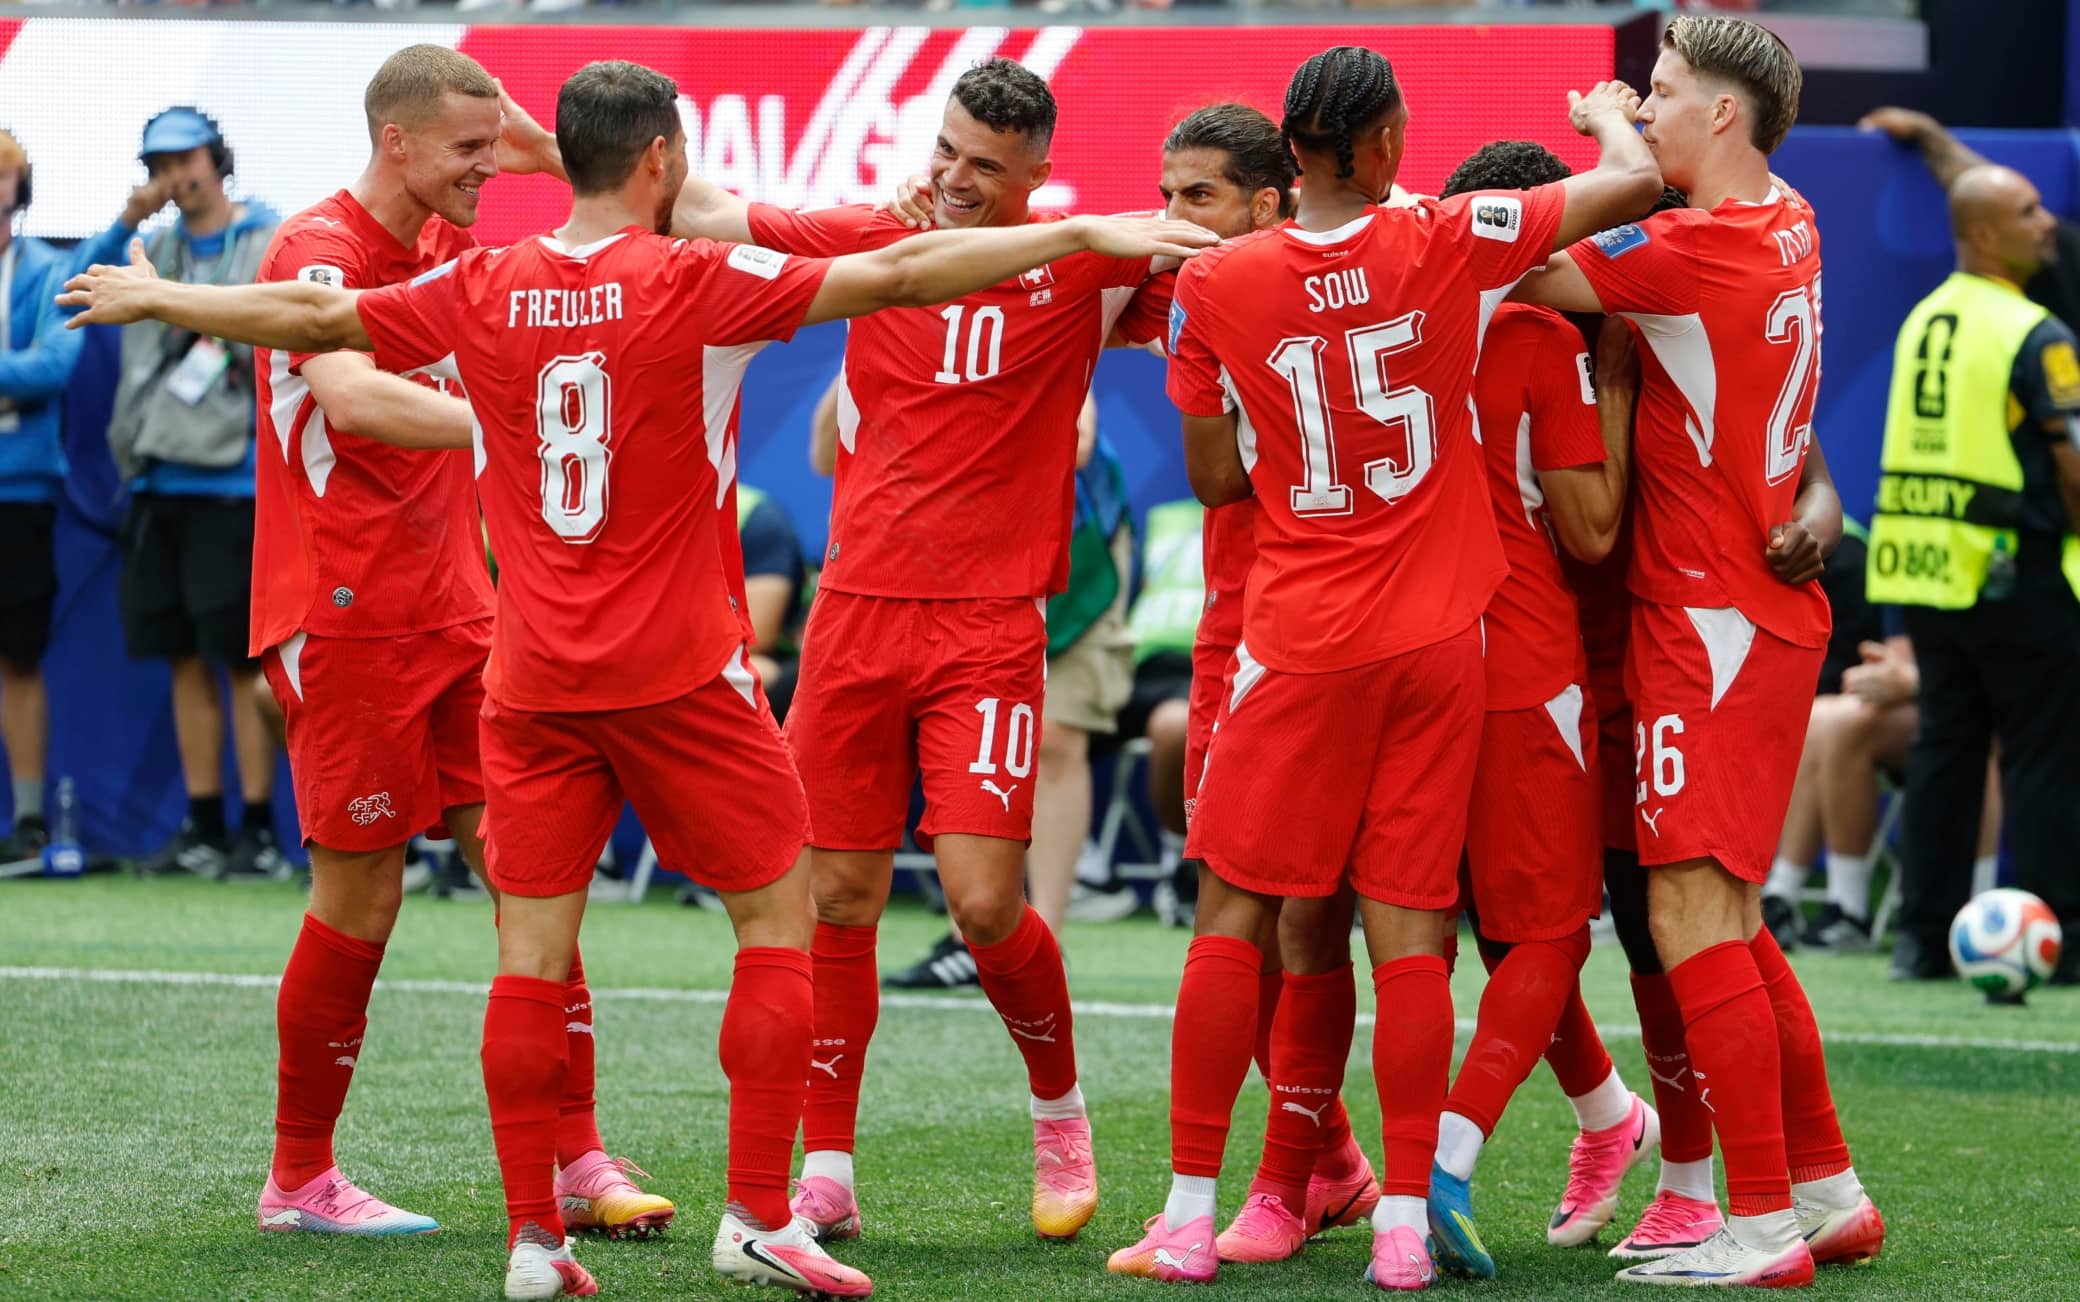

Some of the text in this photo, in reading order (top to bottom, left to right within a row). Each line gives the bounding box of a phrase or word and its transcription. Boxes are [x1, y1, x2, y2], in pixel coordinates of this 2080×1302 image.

[508, 282, 622, 328] FREULER
[1304, 267, 1370, 312] SOW
[935, 305, 1004, 384] 10
[536, 351, 613, 544] 8
[1266, 309, 1438, 519] 15
[969, 697, 1034, 778] 10
[1275, 1084, 1333, 1095] suisse
